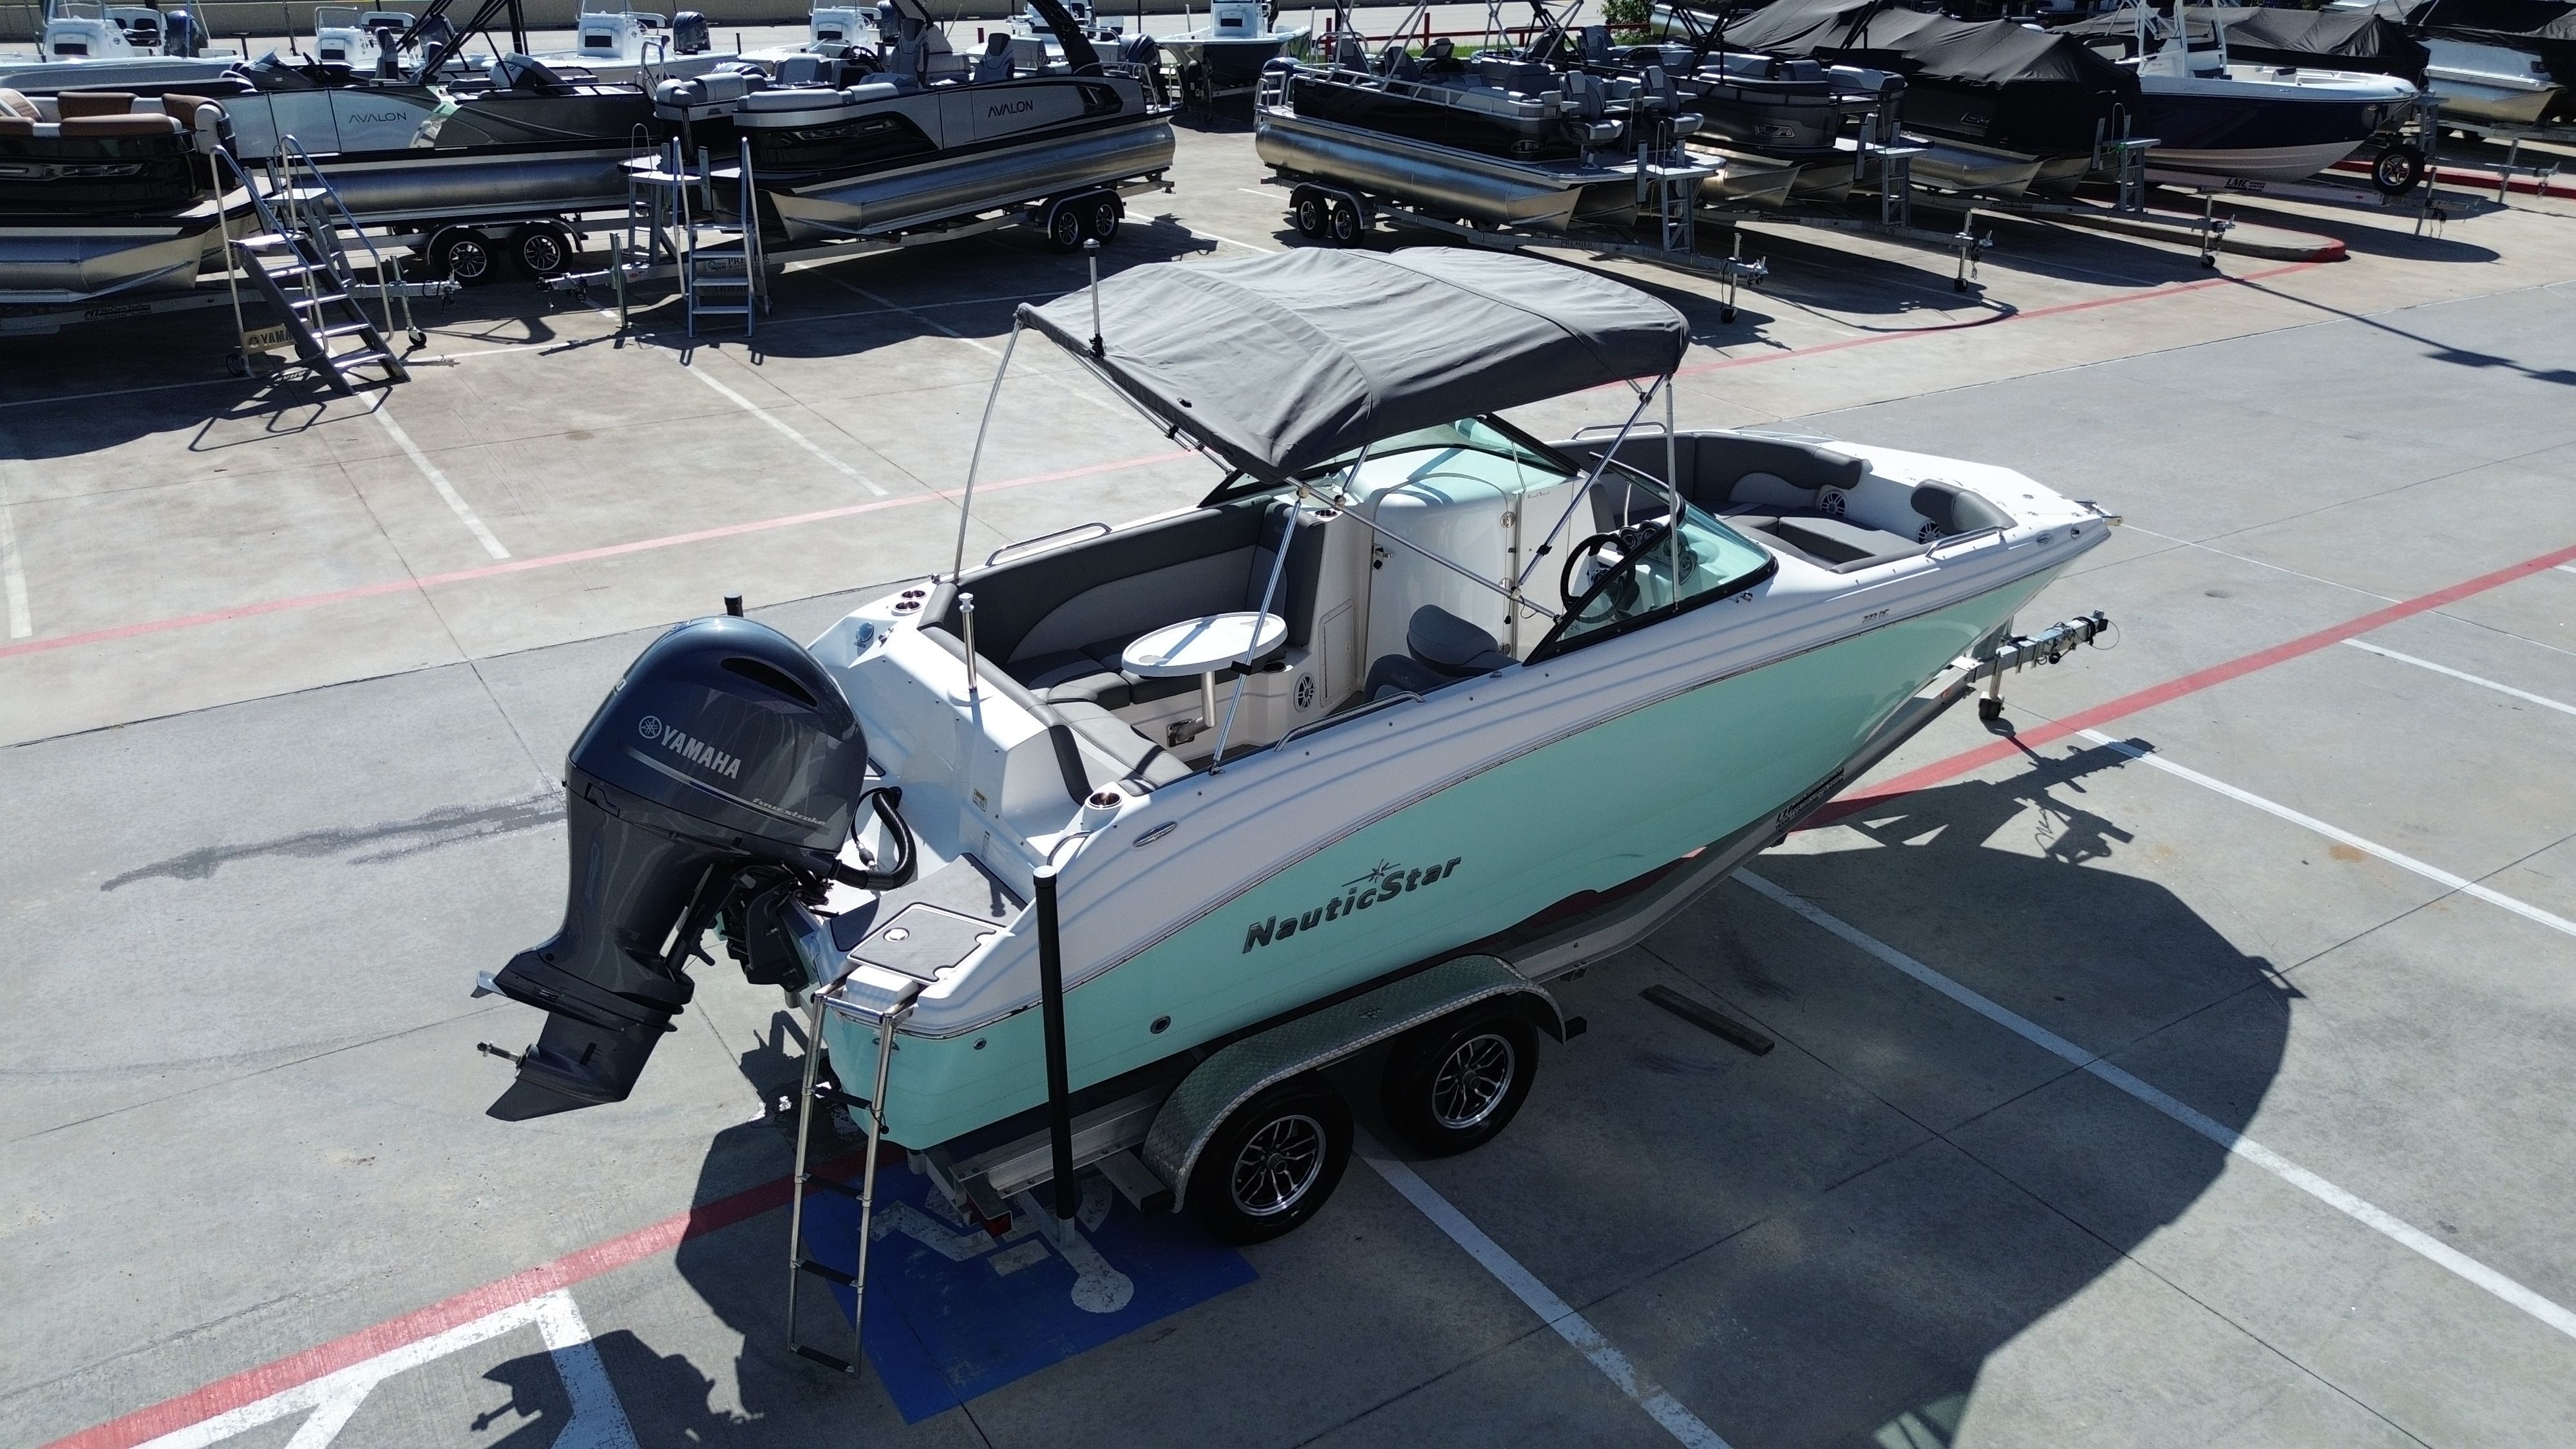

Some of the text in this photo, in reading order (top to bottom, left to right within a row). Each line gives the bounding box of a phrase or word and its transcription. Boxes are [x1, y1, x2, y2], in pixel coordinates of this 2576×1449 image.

[349, 112, 407, 124] AVALON
[988, 100, 1033, 118] AVALON
[2226, 178, 2250, 187] LMC
[661, 724, 741, 779] YAMAHA
[1242, 856, 1462, 954] NauticStar
